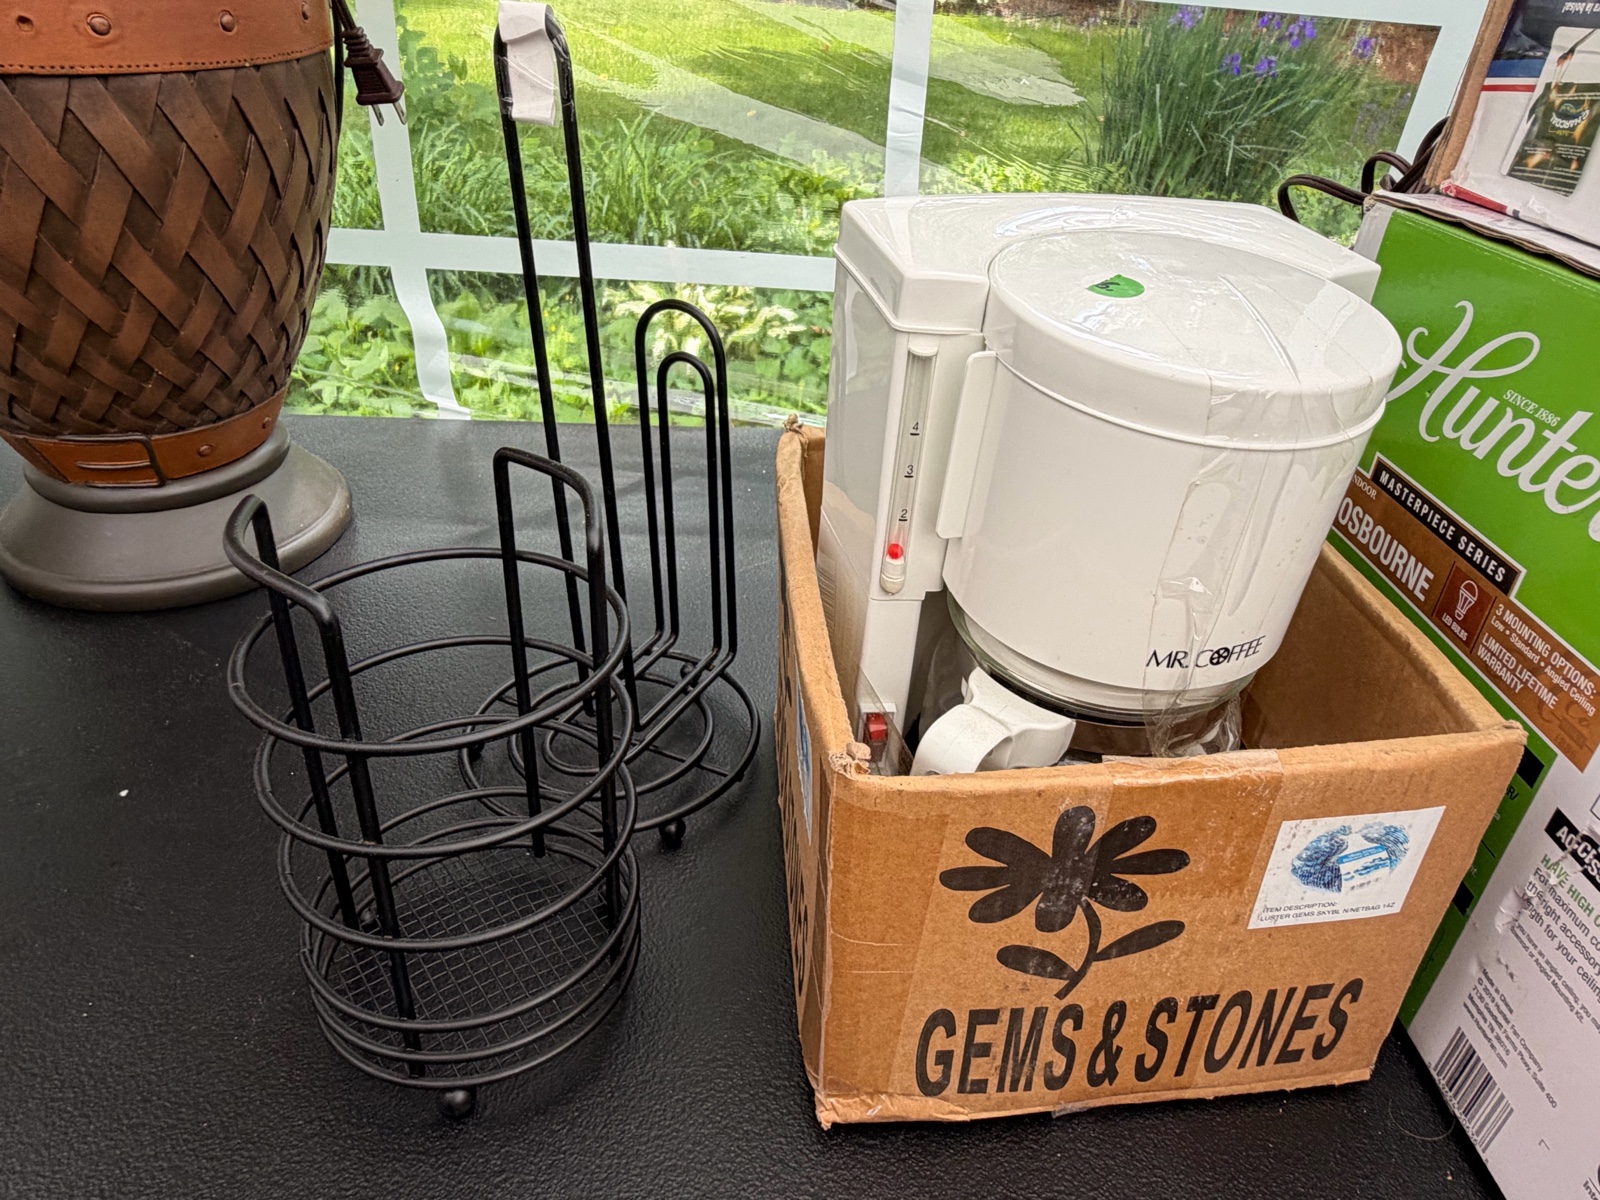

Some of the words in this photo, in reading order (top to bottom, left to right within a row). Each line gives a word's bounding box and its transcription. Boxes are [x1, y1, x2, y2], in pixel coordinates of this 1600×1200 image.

[912, 421, 919, 432] 4
[1503, 389, 1538, 414] SINCE
[1534, 408, 1561, 427] 1886
[906, 464, 914, 475] 3
[900, 508, 908, 518] 2
[1379, 470, 1456, 541] MASTERPIECE
[1457, 535, 1506, 583] SERIES
[1337, 497, 1434, 602] OSBOURNE
[1441, 612, 1453, 626] LED
[1450, 621, 1468, 641] BULBS
[1146, 649, 1189, 668] MR.
[1195, 635, 1266, 668] COFFEE
[1477, 645, 1524, 694] WARRANTY
[1481, 632, 1517, 670] LIMITED
[1515, 664, 1559, 710] LIFETIME
[1490, 615, 1505, 632] Low
[1509, 632, 1541, 664] Standard
[1544, 665, 1571, 692] Angled
[1568, 687, 1597, 717] Ceiling
[1495, 603, 1504, 616] 3
[1503, 609, 1551, 658] MOUNTING
[1550, 651, 1597, 699] OPTIONS:
[1262, 905, 1282, 913] ITEM
[1283, 901, 1337, 911] DESCRIPTION:
[1540, 853, 1571, 889] HAVE
[1567, 884, 1595, 917] HIGH
[1259, 912, 1291, 921] LUSTER
[1291, 911, 1315, 919] GEMS
[1540, 899, 1562, 926] right
[1547, 886, 1590, 937] maximum
[1543, 923, 1558, 942] for
[1555, 940, 1578, 966] your
[1482, 967, 1495, 988] Made
[1499, 993, 1514, 1015] China
[1534, 957, 1553, 981] Angled
[1550, 980, 1576, 1012] Mounting
[915, 1002, 1084, 1097] GEMS
[1086, 1000, 1128, 1087] &
[1134, 977, 1364, 1083] STONES
[1494, 1001, 1511, 1026] Hunter
[1510, 1023, 1520, 1039] Fan
[1519, 1037, 1543, 1073] Company
[1545, 1092, 1557, 1108] 400
